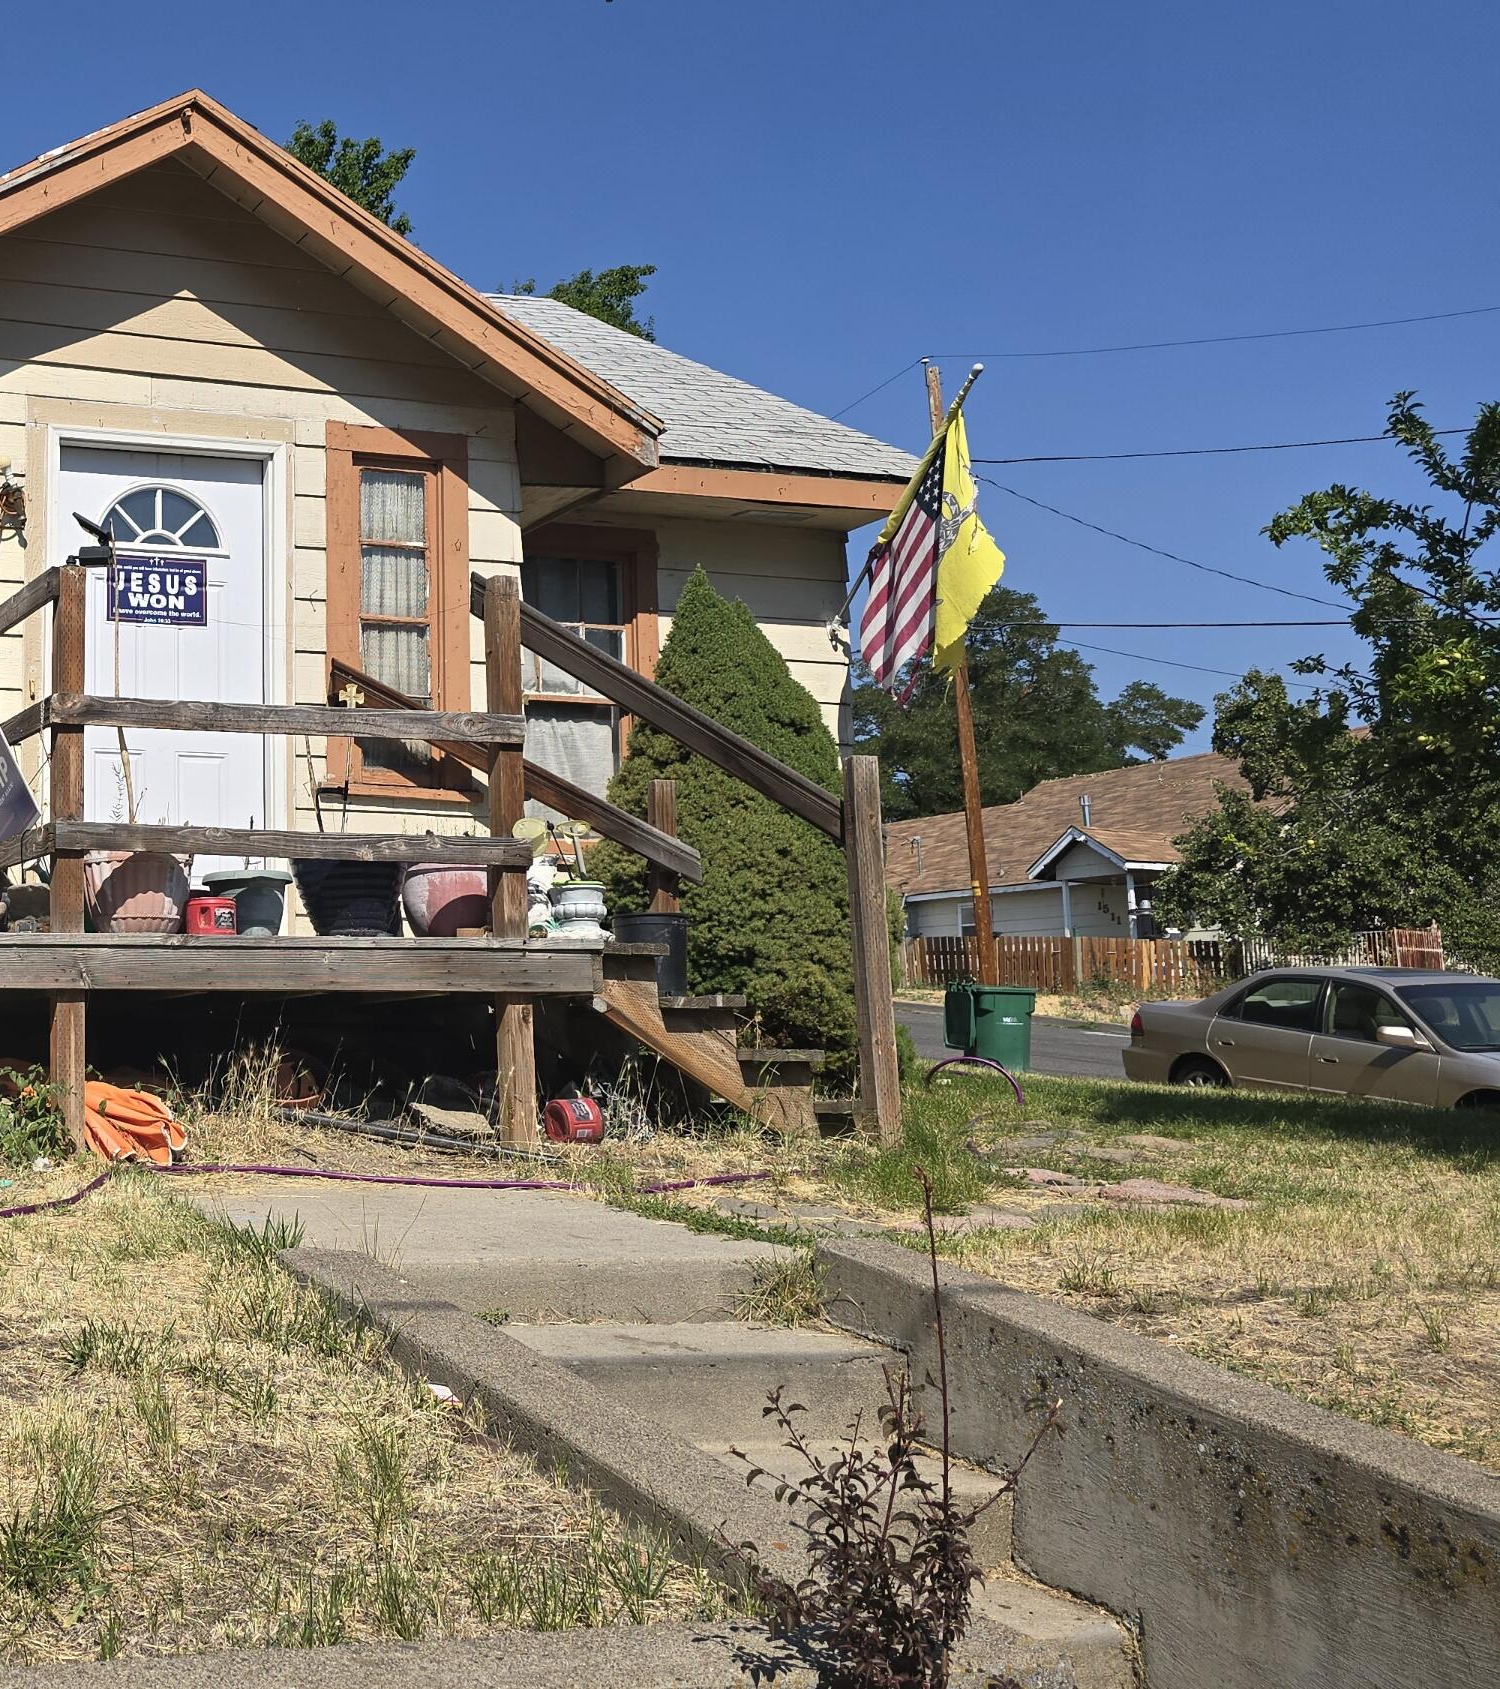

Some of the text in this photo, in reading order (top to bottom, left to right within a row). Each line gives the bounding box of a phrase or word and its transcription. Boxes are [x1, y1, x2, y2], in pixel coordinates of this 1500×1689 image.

[113, 571, 197, 595] JESUS
[128, 592, 185, 609] WON
[134, 608, 167, 617] overcome
